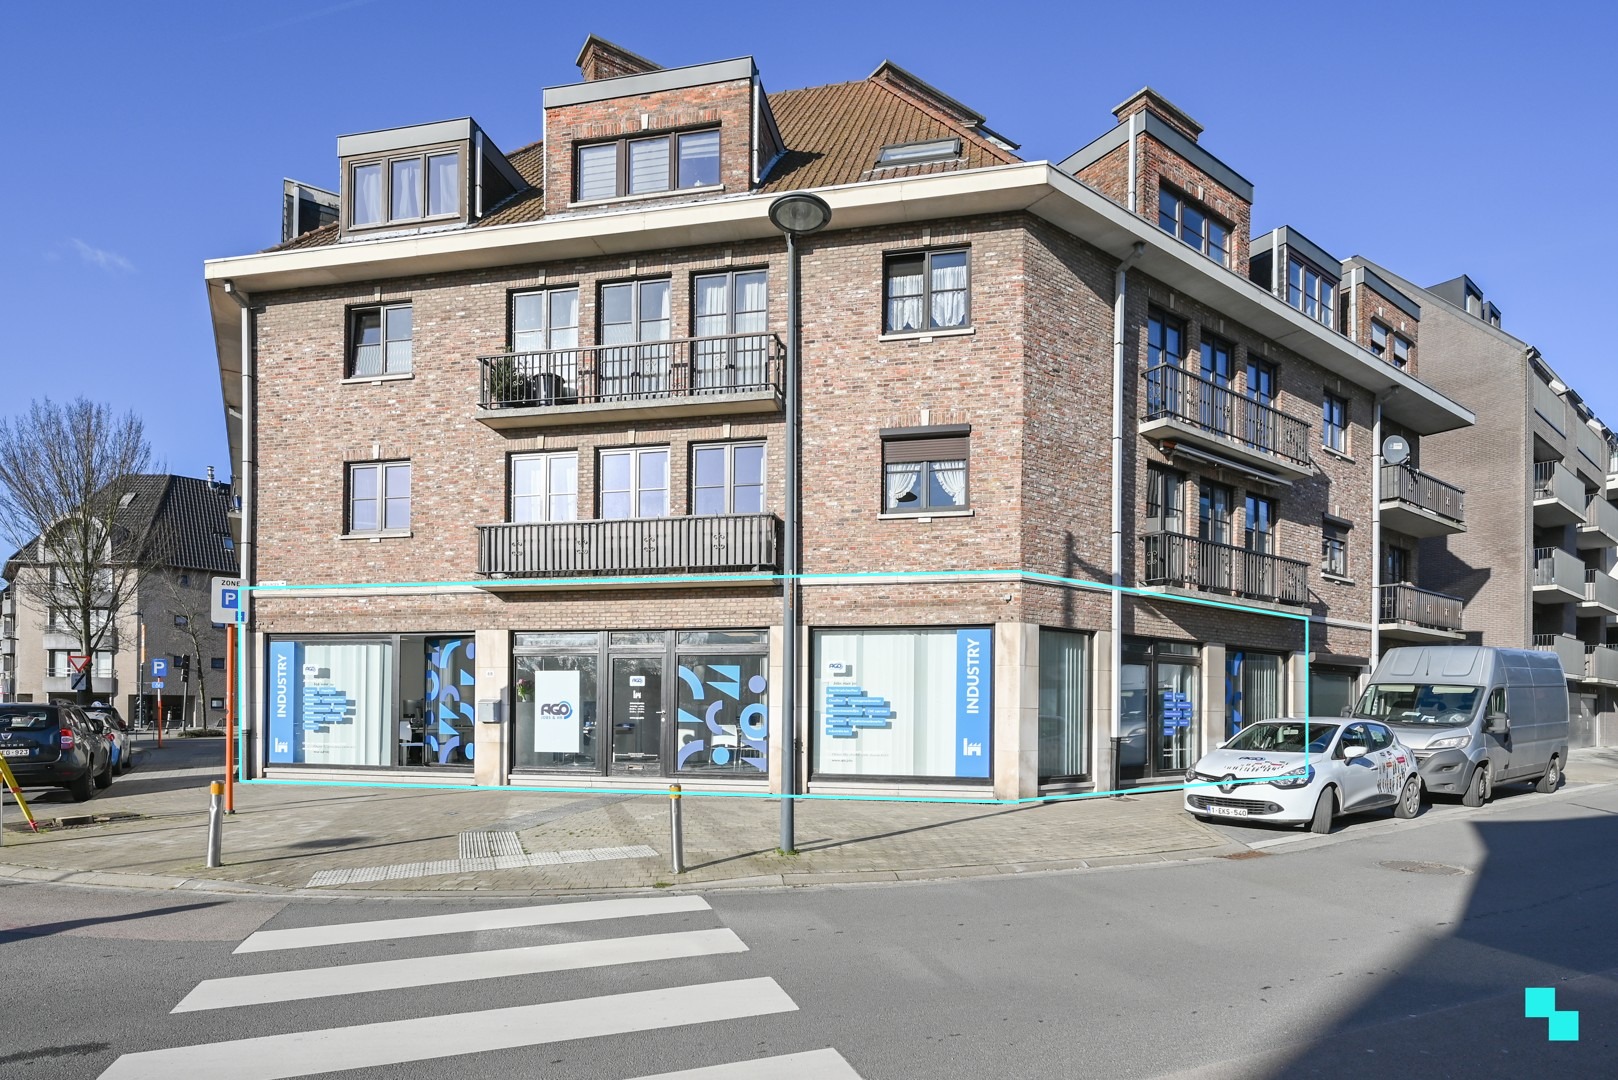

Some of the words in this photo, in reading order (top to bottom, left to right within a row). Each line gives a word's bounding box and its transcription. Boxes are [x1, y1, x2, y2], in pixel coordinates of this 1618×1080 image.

[225, 592, 236, 605] P
[153, 661, 165, 674] P
[967, 638, 980, 714] INDUSTRY
[277, 654, 287, 718] INDUSTRY
[541, 703, 570, 715] AGO
[1211, 807, 1247, 817] 1-EKS-540
